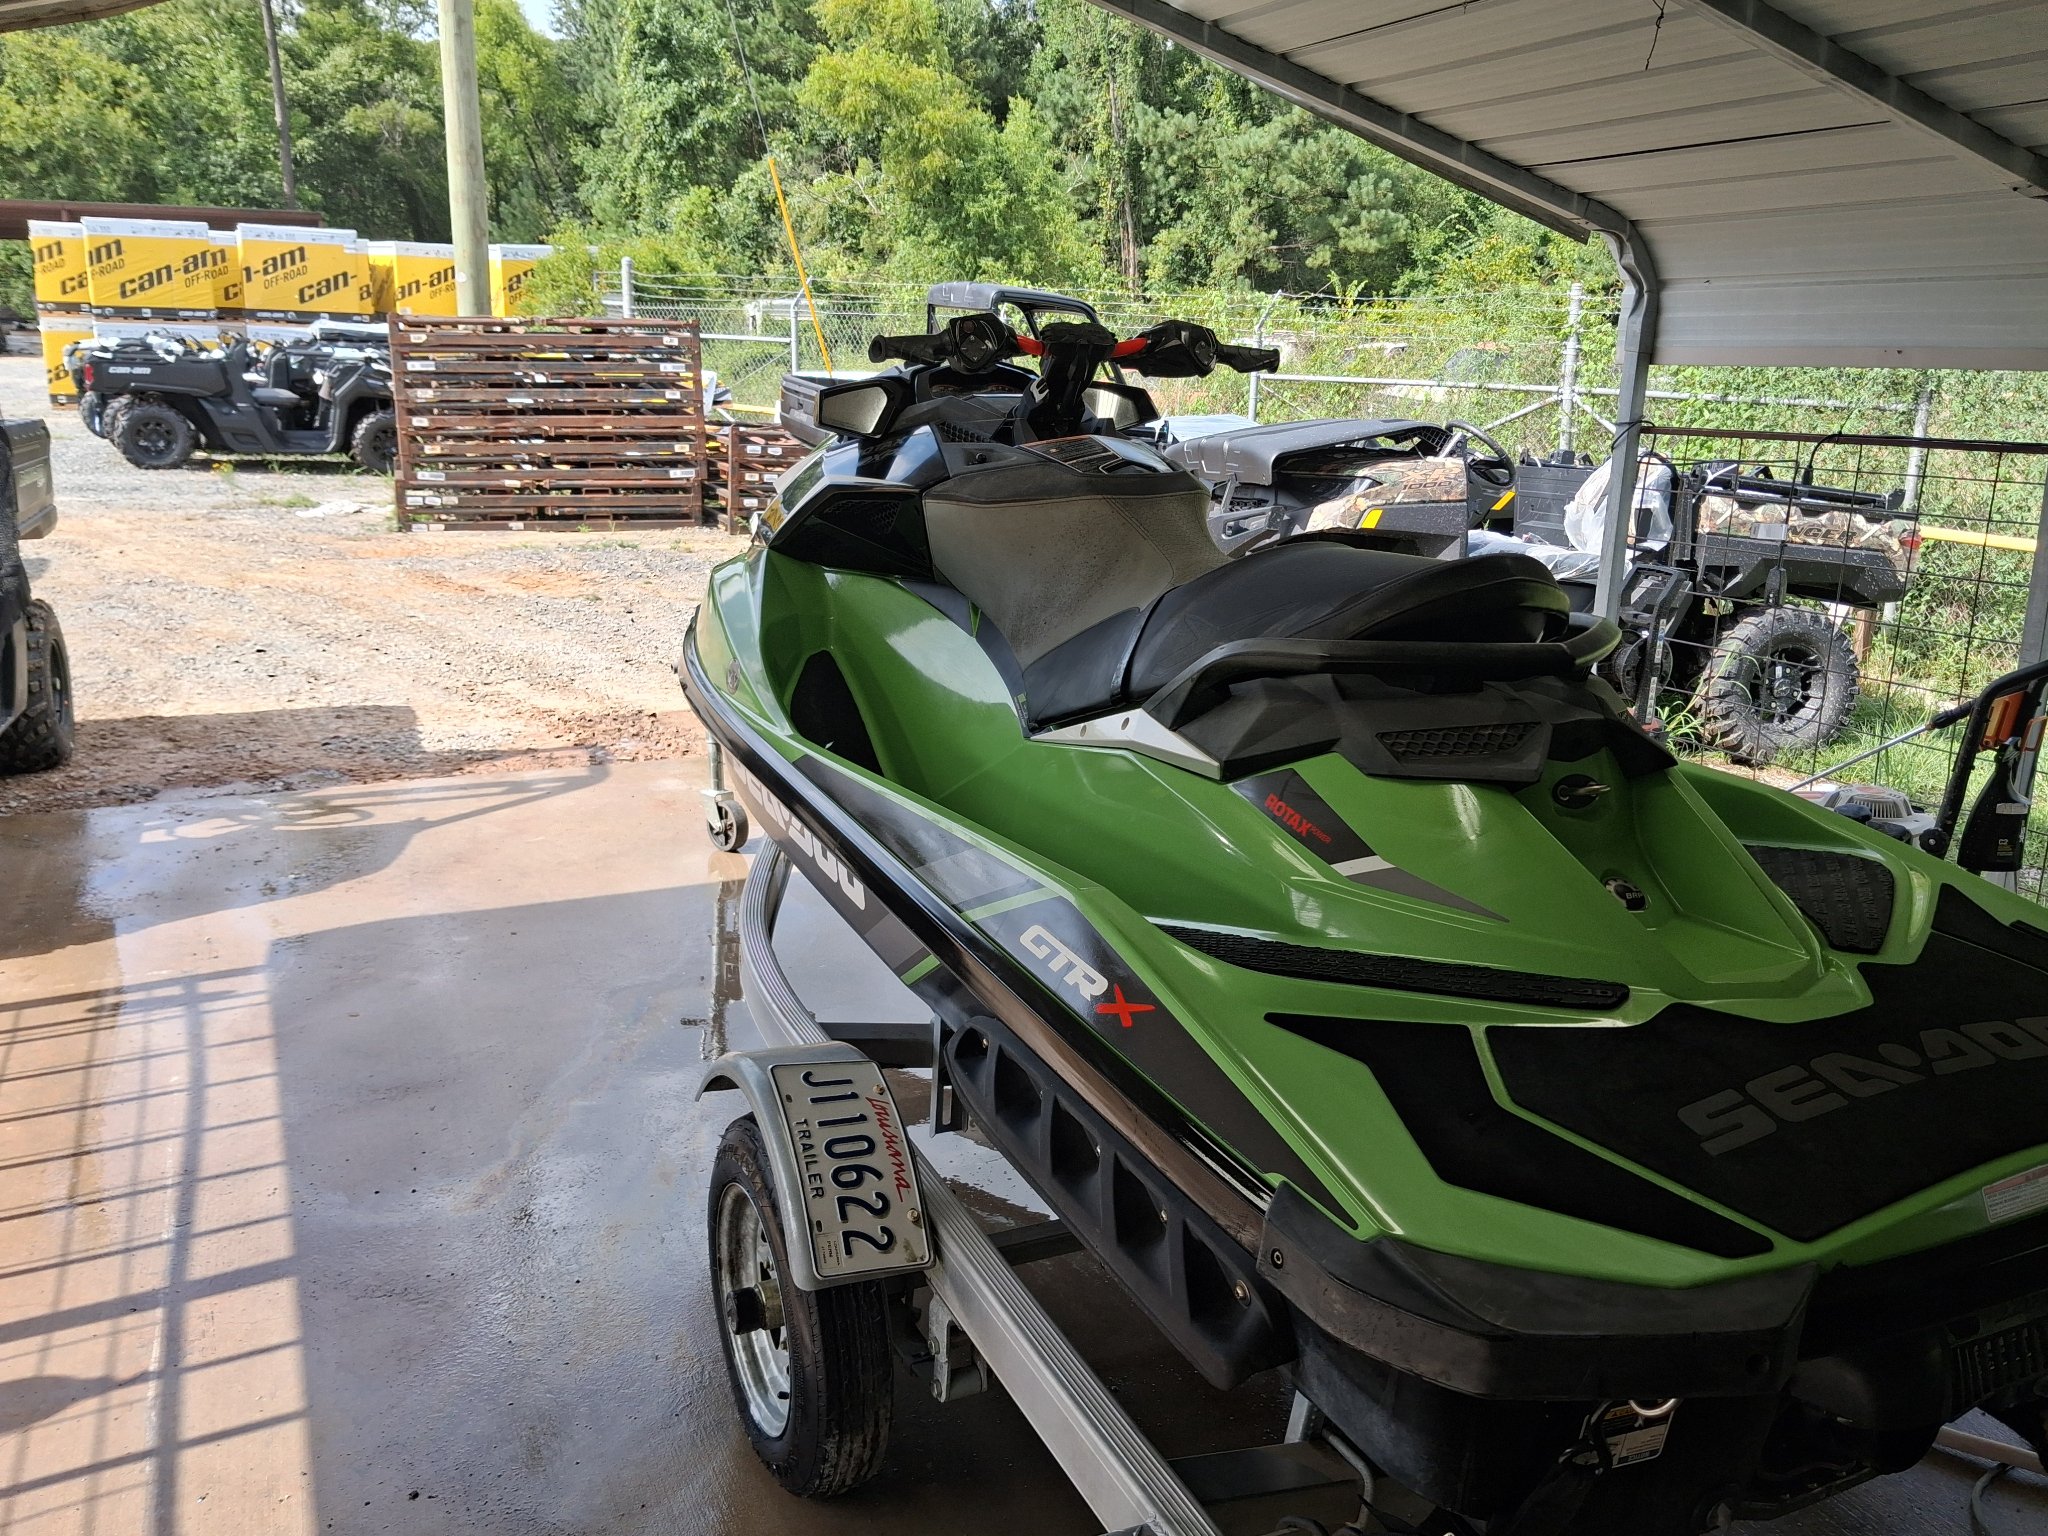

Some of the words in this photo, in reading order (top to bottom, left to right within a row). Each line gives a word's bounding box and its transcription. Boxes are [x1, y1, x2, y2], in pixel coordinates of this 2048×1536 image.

[184, 266, 229, 288] OFF-ROAD
[263, 265, 308, 289] OFF-ROAD
[1788, 525, 1857, 541] NGER
[1265, 792, 1313, 837] ROTAX
[793, 1117, 826, 1199] TRAILER
[801, 1070, 896, 1258] J110622
[865, 1096, 911, 1203] Louisiana
